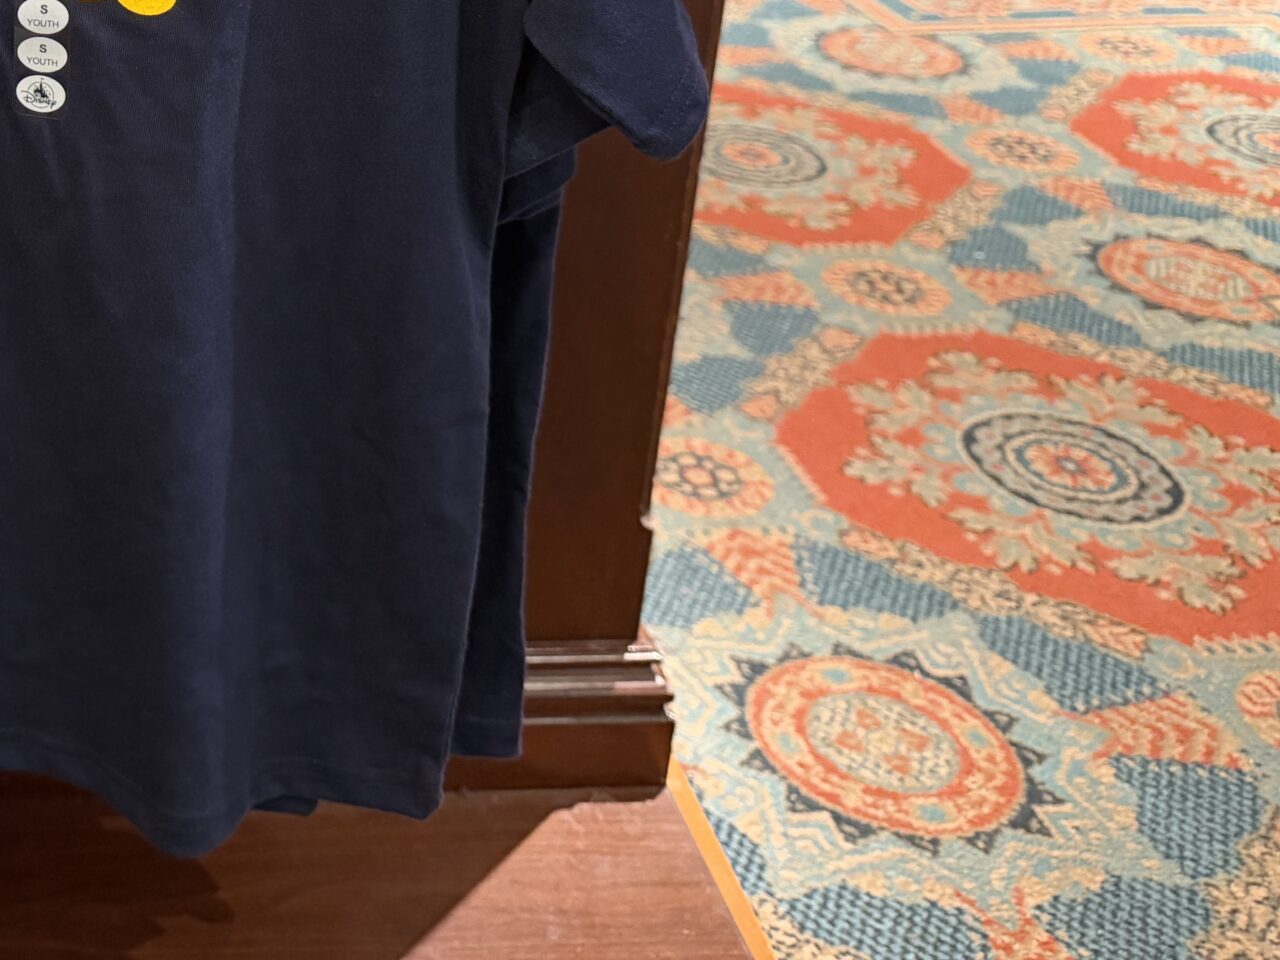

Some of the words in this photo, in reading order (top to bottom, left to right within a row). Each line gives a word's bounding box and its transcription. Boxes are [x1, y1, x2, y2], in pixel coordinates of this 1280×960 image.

[40, 4, 48, 15] S
[27, 18, 60, 28] YOUTH
[39, 44, 47, 54] S
[26, 56, 59, 67] YOUTH
